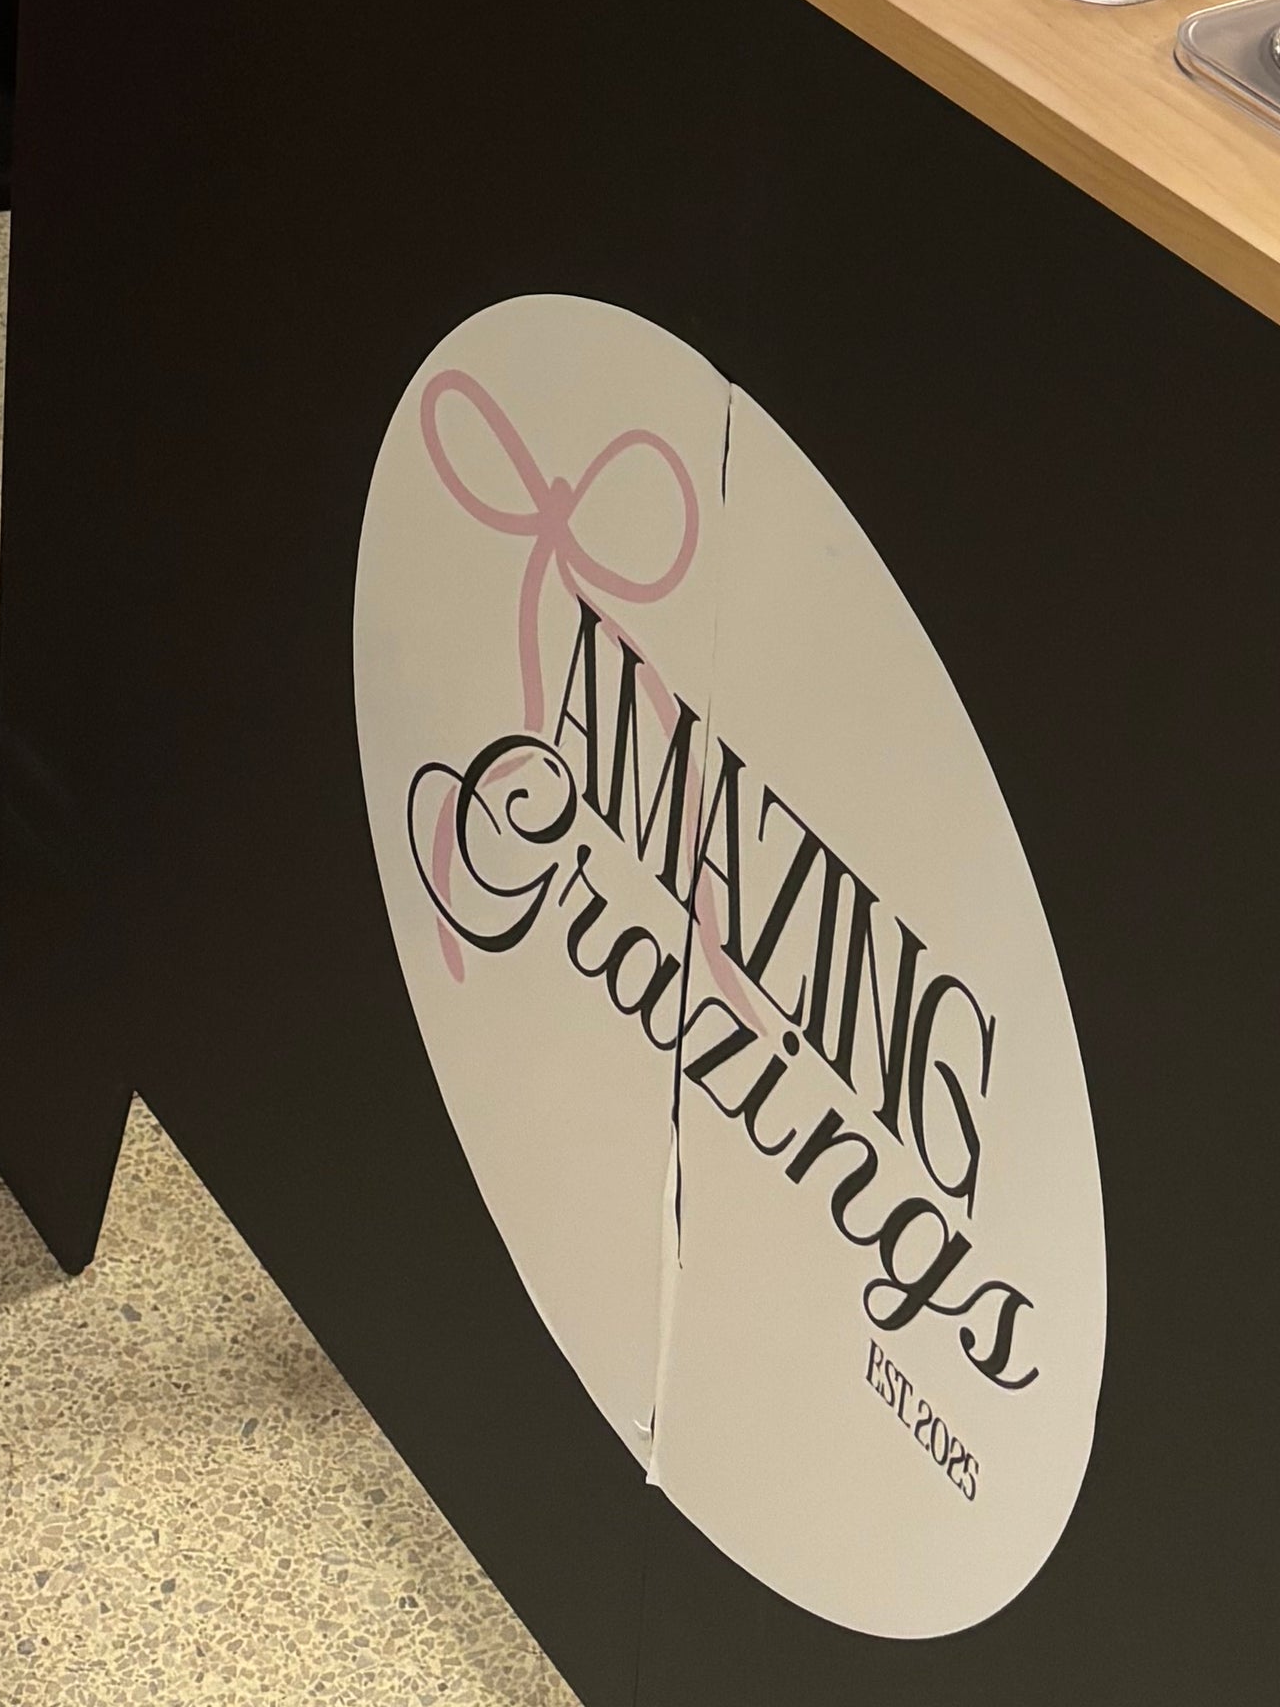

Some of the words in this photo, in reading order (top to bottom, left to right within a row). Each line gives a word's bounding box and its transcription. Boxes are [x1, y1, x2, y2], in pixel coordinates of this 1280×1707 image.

[406, 732, 1040, 1391] Grazings
[554, 595, 996, 1221] AMAZING
[914, 1398, 980, 1502] 2025
